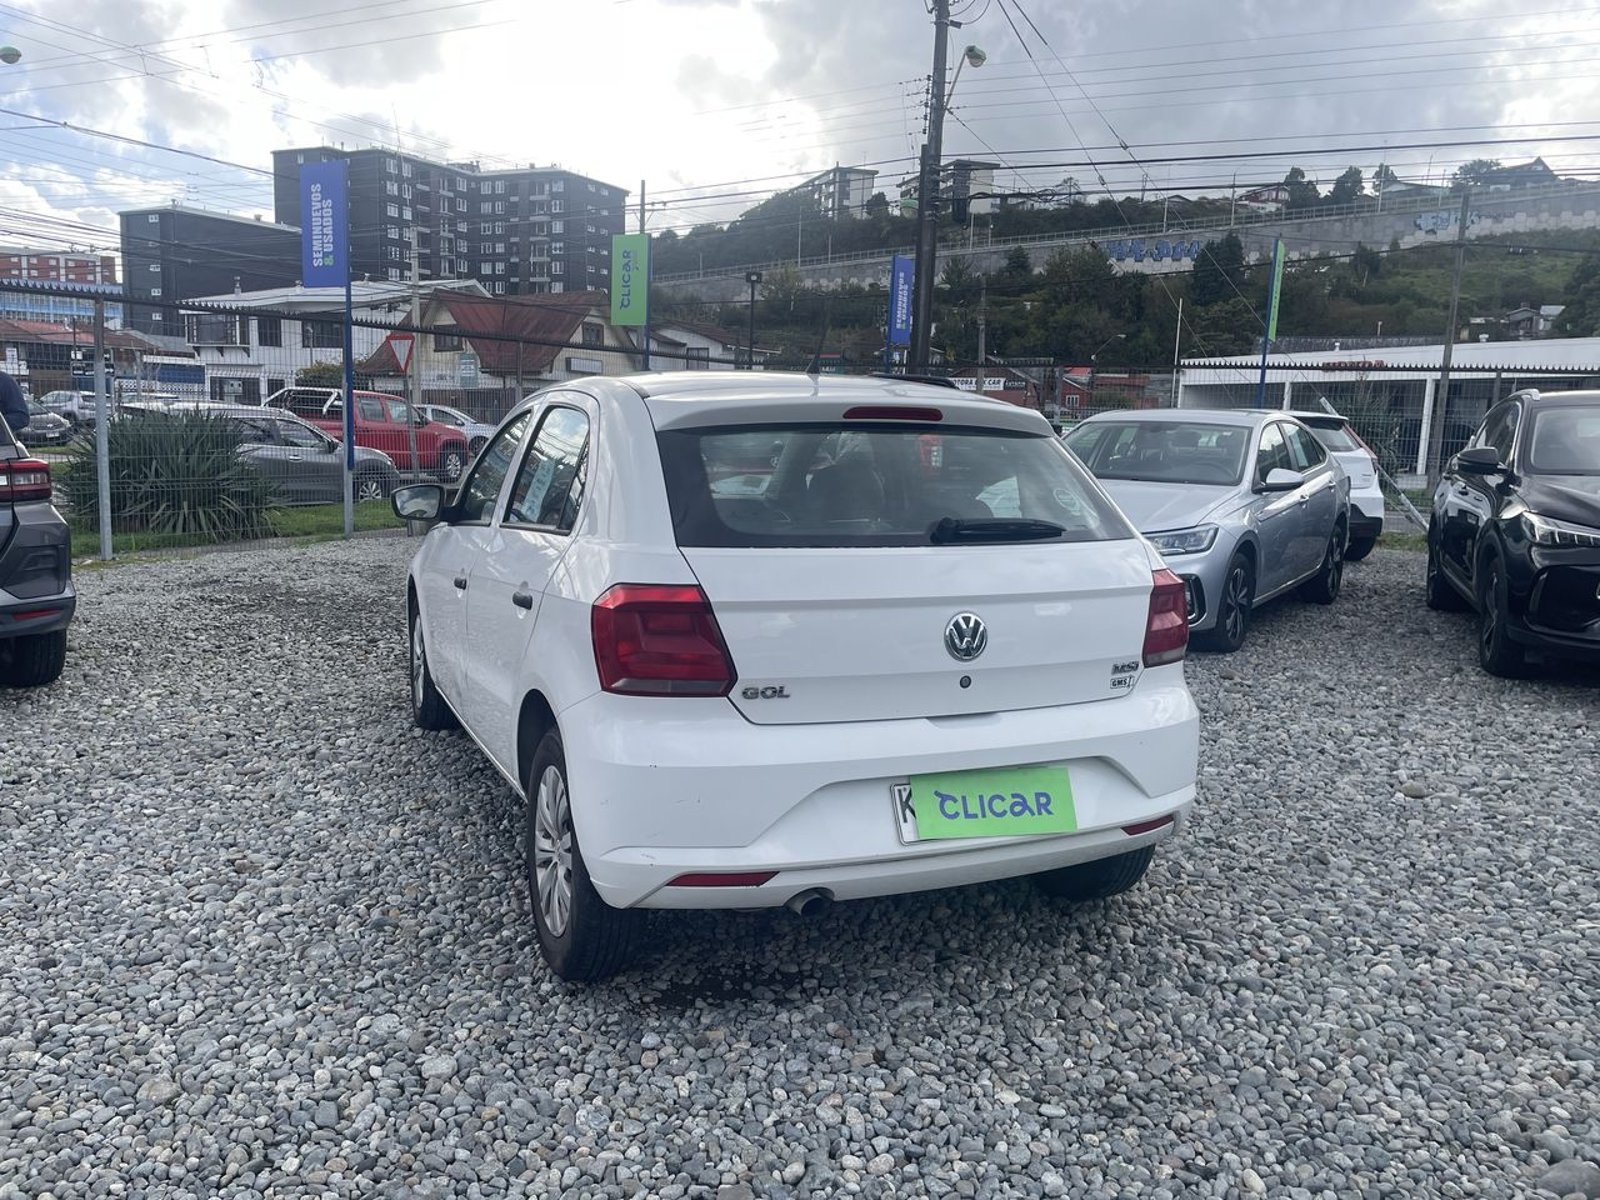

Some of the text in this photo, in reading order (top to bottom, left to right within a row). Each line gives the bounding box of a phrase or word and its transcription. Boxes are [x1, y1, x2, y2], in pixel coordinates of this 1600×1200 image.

[311, 183, 322, 267] SEMINUEVOS
[323, 200, 333, 266] & USADOS
[742, 686, 790, 700] GOL
